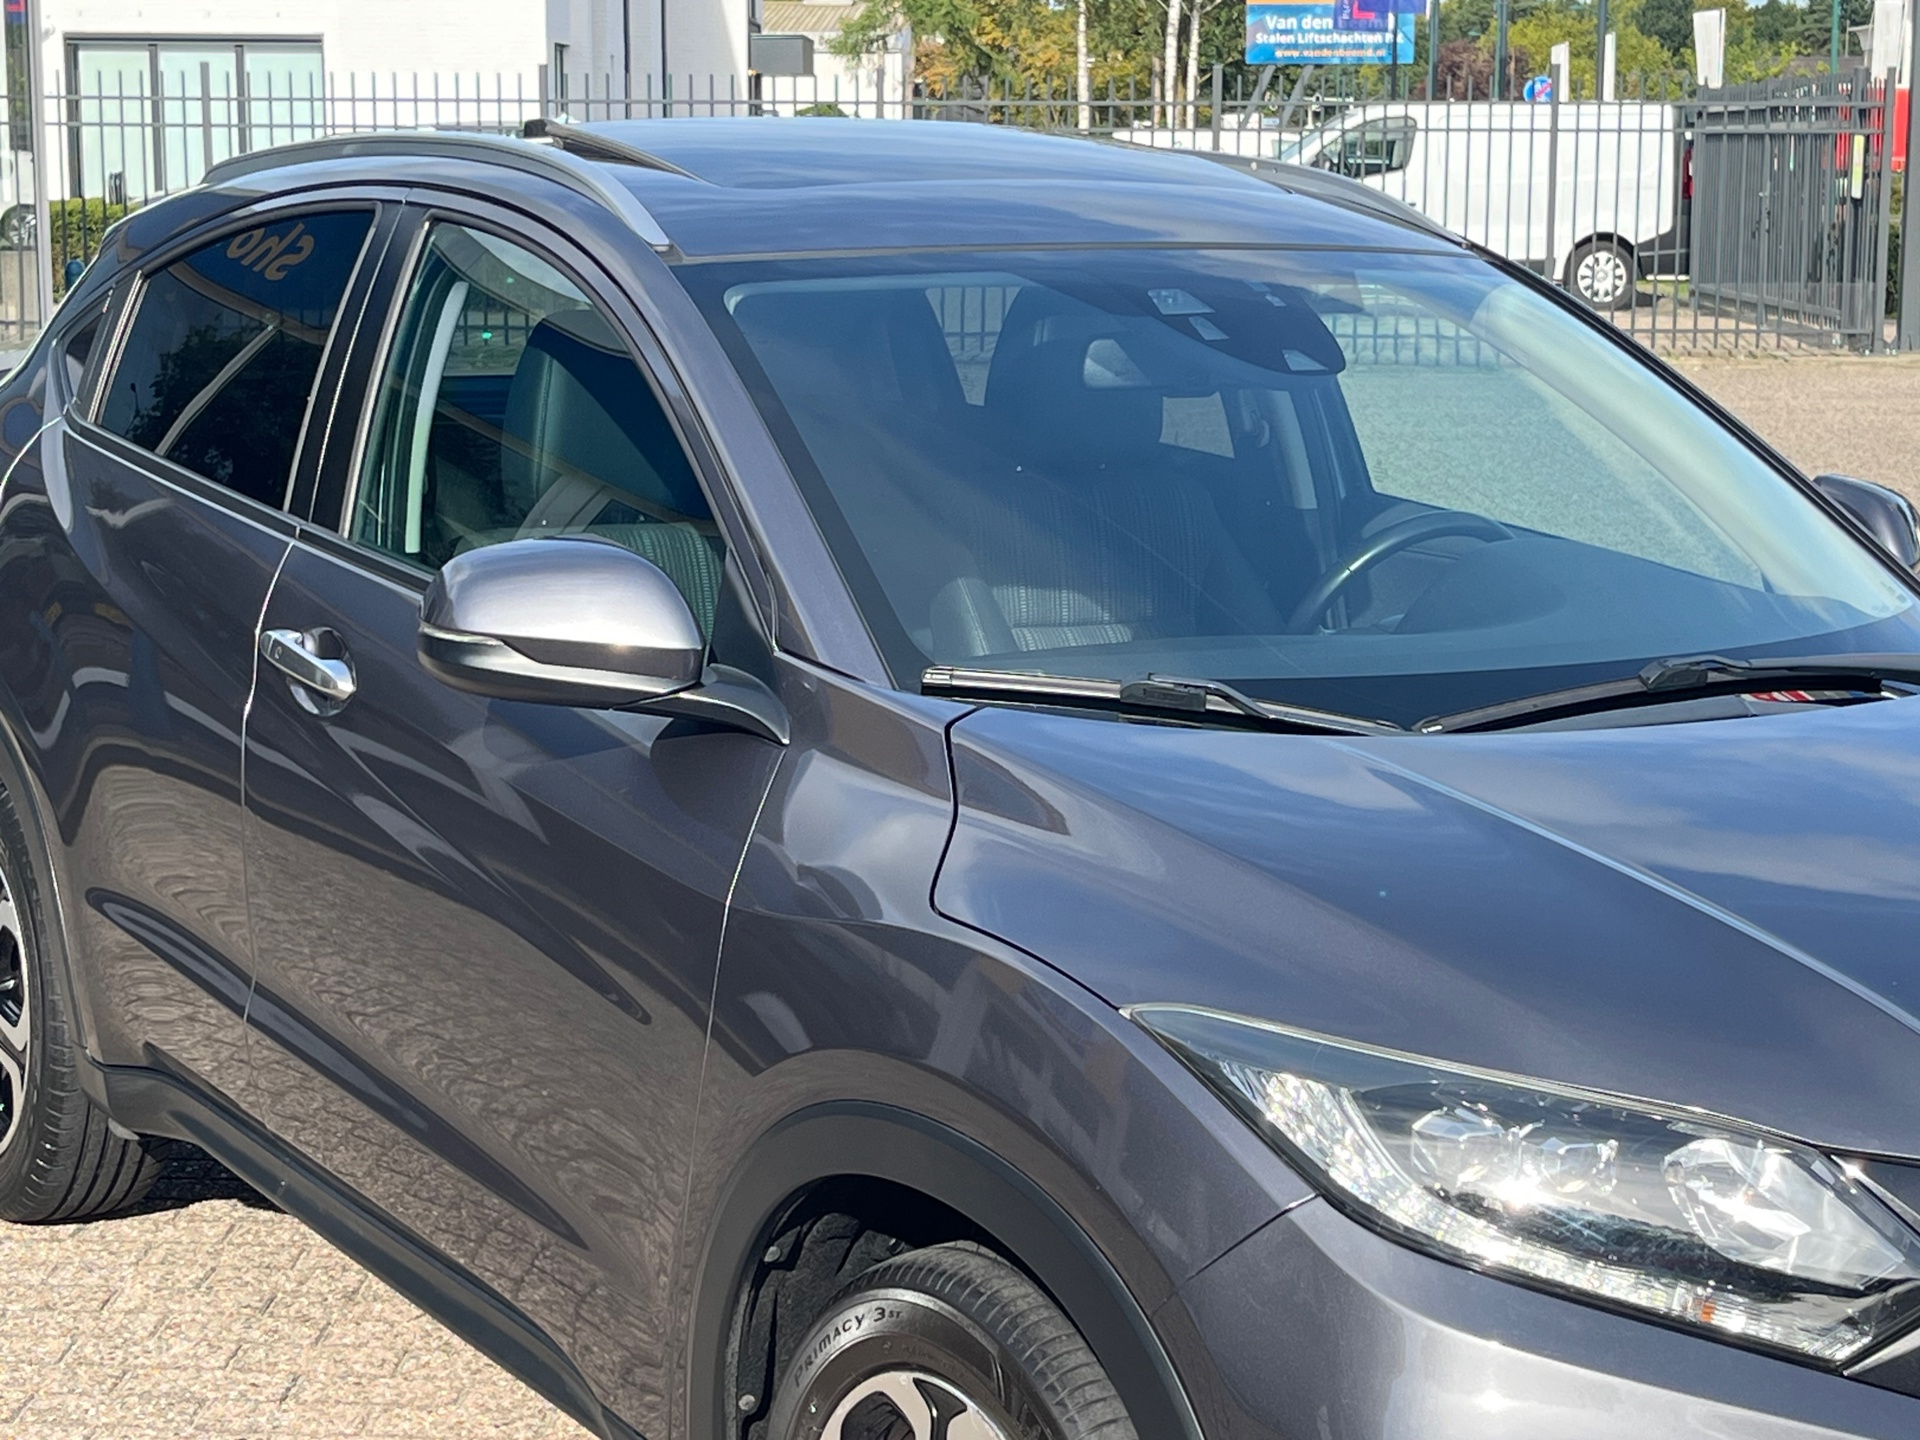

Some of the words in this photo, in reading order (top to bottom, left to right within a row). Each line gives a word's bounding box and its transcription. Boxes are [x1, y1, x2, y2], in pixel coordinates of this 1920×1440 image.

[1265, 14, 1297, 30] Van
[1301, 14, 1334, 30] den
[1255, 32, 1295, 44] Stalen
[1297, 32, 1383, 44] Liftschachten
[793, 1313, 865, 1388] PRIMACY
